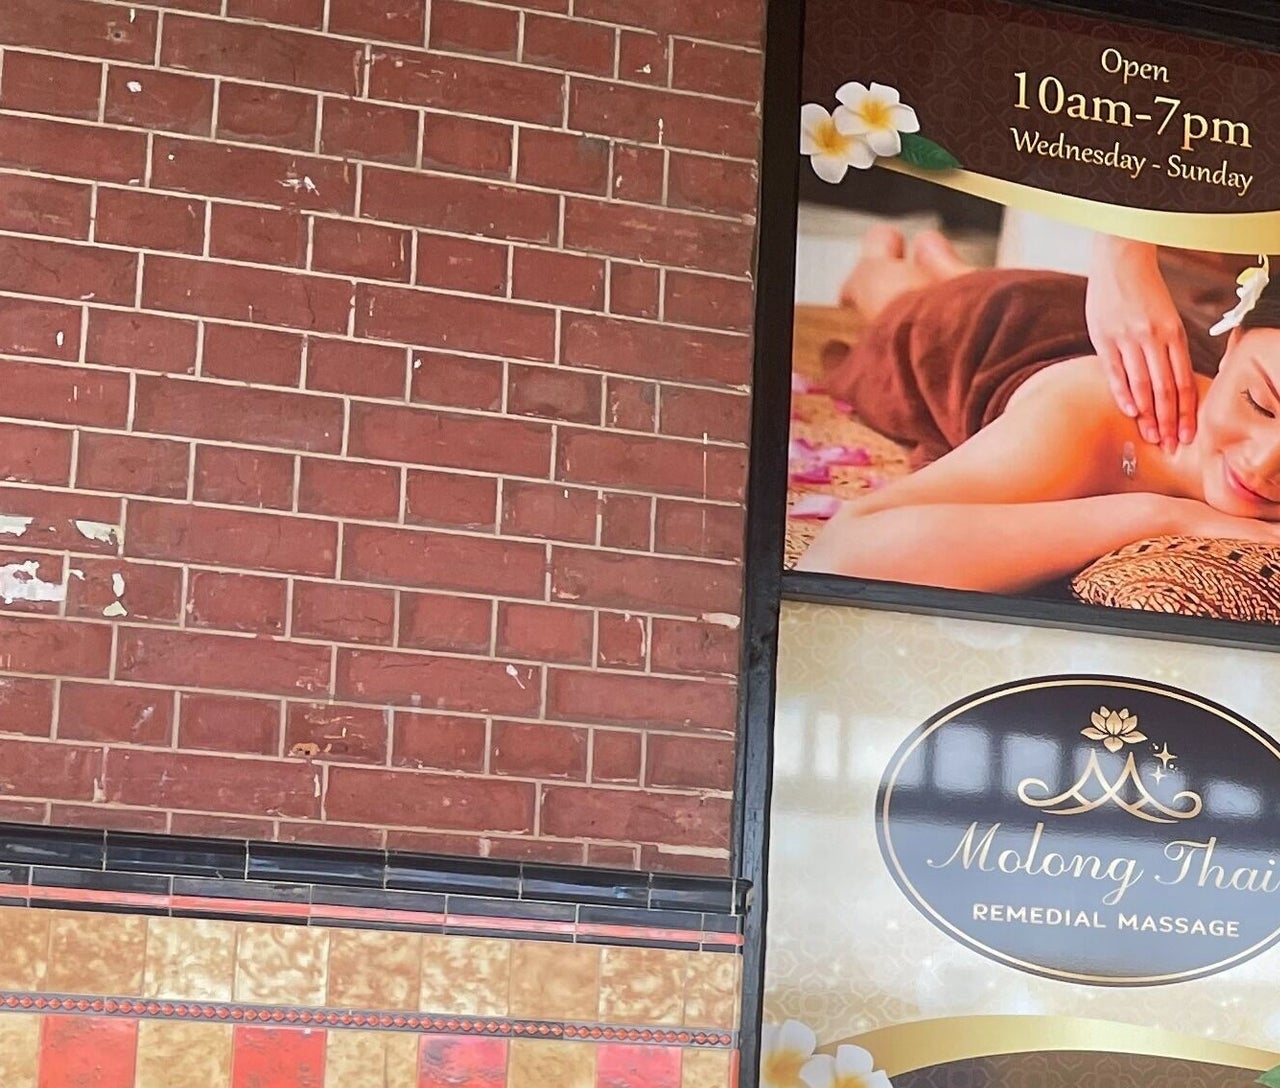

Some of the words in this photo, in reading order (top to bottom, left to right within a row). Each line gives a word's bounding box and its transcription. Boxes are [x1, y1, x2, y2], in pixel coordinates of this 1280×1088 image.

[1101, 48, 1170, 85] Open
[1013, 71, 1253, 152] 10am-7pm
[1010, 127, 1147, 179] Wednesday
[1167, 153, 1253, 197] Sunday
[926, 821, 1144, 906] Molong
[972, 903, 1107, 928] REMEDIAL
[1117, 912, 1240, 938] MASSAGE
